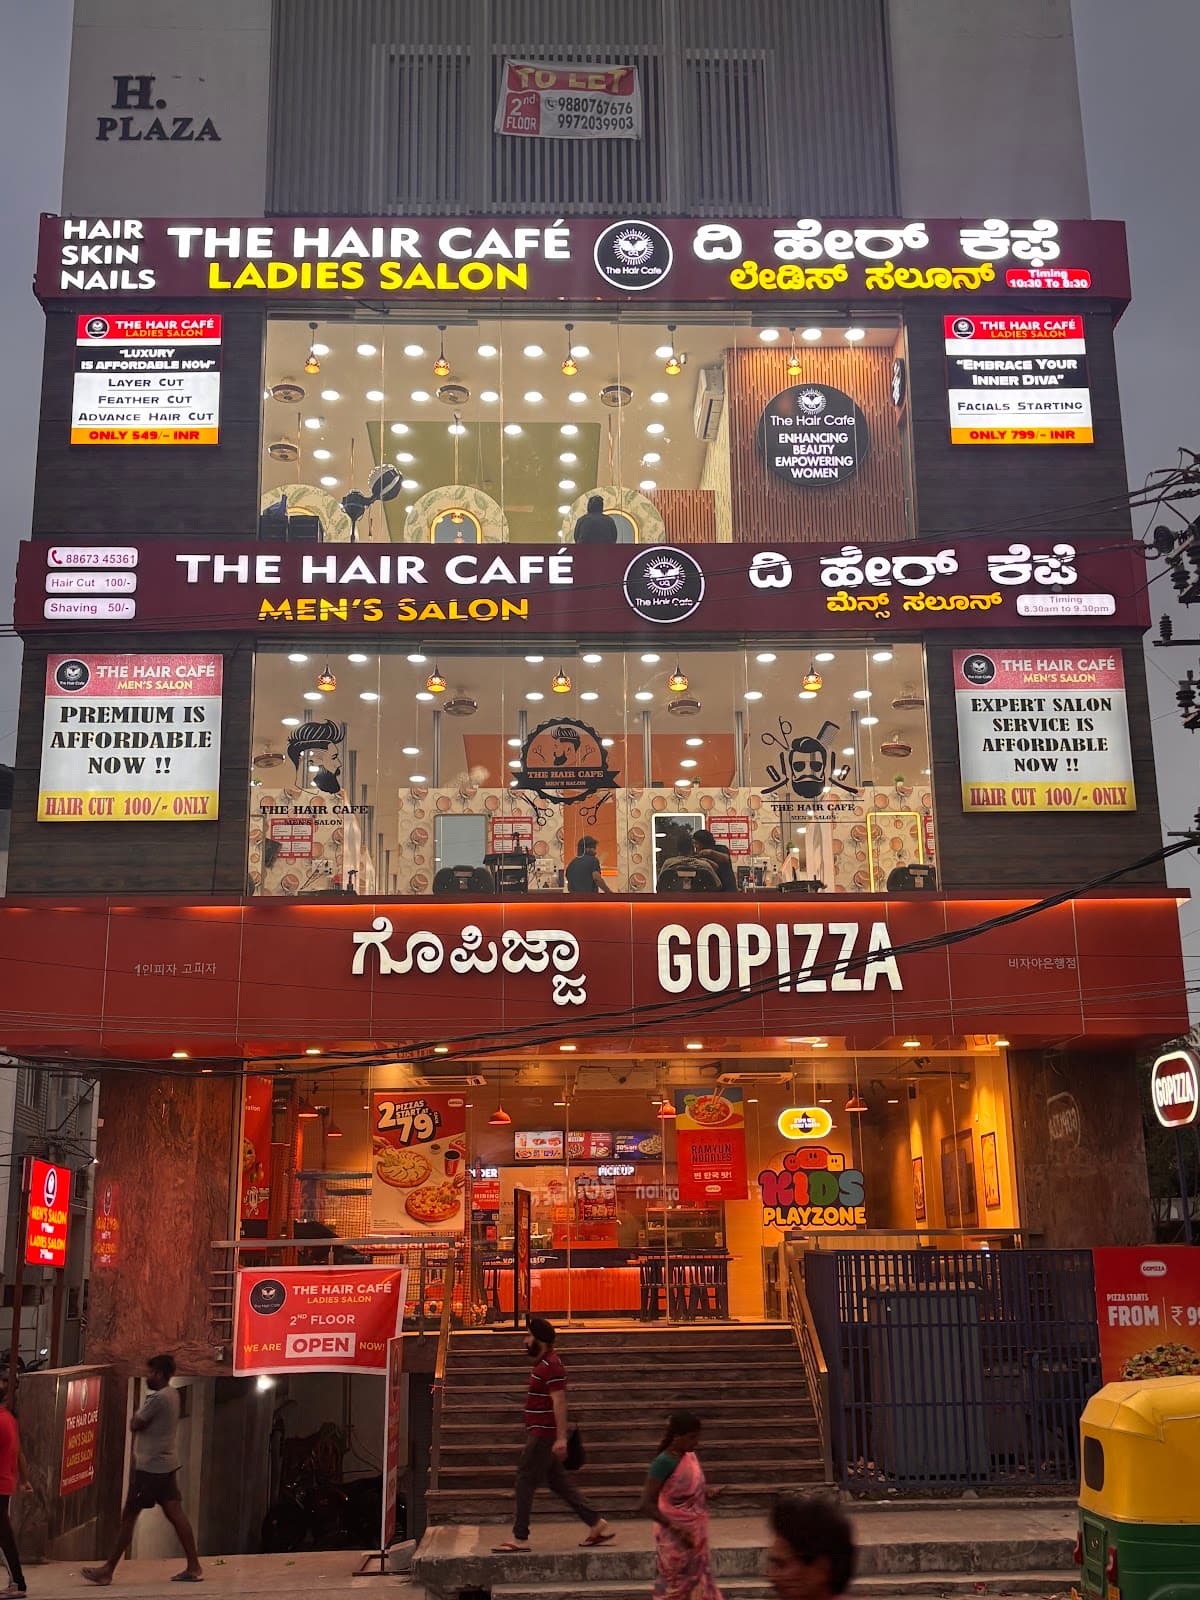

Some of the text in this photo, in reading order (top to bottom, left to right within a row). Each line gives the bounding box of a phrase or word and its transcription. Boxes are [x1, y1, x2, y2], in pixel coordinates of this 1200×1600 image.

[515, 67, 628, 93] TO LET
[112, 76, 167, 110] H.
[510, 93, 536, 116] 2nd
[558, 97, 633, 115] 9880767676
[96, 116, 221, 141] PLAZA
[506, 116, 537, 130] FLOOR
[558, 113, 633, 130] 9972039903
[62, 220, 144, 240] HAIR
[166, 219, 570, 259] THE HAIR CAFÉ
[693, 223, 742, 260] ದಿ
[773, 219, 929, 260] ಹೇರ್
[61, 244, 140, 265] SKIN
[208, 262, 528, 291] LADIES SALON
[606, 267, 621, 275] The
[621, 267, 639, 275] Hair
[1028, 270, 1068, 280] Timing
[60, 269, 157, 290] NAILS
[1010, 279, 1042, 288] 10:30
[1044, 279, 1060, 288] To
[115, 318, 214, 330] THE HAIR CAFÉ
[980, 319, 1076, 330] THE HAIR CAFÉ
[166, 329, 203, 337] SALON
[991, 330, 1066, 338] LADIES SALON
[95, 360, 180, 370] AFFORDABLE
[1035, 359, 1077, 369] YOUR
[159, 378, 184, 387] CUT
[972, 374, 1019, 386] INNER
[167, 395, 192, 404] CUT
[189, 413, 214, 421] CUT
[770, 415, 855, 426] The Hair Cafe
[89, 431, 199, 441] ONLY 549/- INR
[778, 433, 849, 444] ENHANCING
[970, 431, 1007, 440] ONLY
[1050, 430, 1075, 439] INR
[792, 444, 835, 455] BEAUTY
[775, 456, 854, 467] EMPOWERING
[791, 468, 839, 478] WOMEN
[66, 554, 135, 564] 88673 45361
[176, 547, 574, 584] THE HAIR CAFÉ
[749, 551, 792, 588] ದಿ
[51, 578, 130, 588] Hair Cut 100/-
[1050, 596, 1083, 604] Timing
[50, 603, 129, 614] Shaving 50/-
[257, 598, 529, 621] MEN'S SALON
[95, 662, 215, 678] THE HAIR CAFÉ
[1002, 655, 1116, 671] THE HAIR CAFÉ
[118, 680, 192, 690] MEN'S SALON
[1024, 673, 1096, 683] MEN'S SALON
[971, 697, 1112, 712] EXPERT SALON
[60, 706, 205, 723] PREMIUM IS
[992, 717, 1094, 732] SERVICE IS
[50, 731, 212, 749] AFFORDABLE
[982, 737, 1109, 752] AFFORDABLE
[88, 757, 146, 774] NOW
[1013, 758, 1058, 772] NOW
[970, 787, 1127, 806] HAIR CUT 100/- ONLY
[45, 796, 209, 816] HAIR CUT 100/- ONLY
[260, 805, 369, 815] THE HAIR CAFE
[771, 803, 855, 812] THE HAIR CAFE
[656, 922, 903, 993] GOPIZZA
[1156, 1072, 1194, 1107] GOPIZZA
[396, 1100, 424, 1111] PIZZAS
[378, 1101, 396, 1129] 2
[397, 1113, 434, 1142] 79
[758, 1170, 865, 1206] KIDS
[763, 1206, 867, 1226] PLAYZONE
[292, 1281, 392, 1296] THE HAIR CAFÉ
[341, 1296, 372, 1304] SALON
[1107, 1293, 1149, 1302] PIZZA STARTS
[290, 1313, 355, 1326] 2ND FLOOR
[1108, 1305, 1160, 1326] FROM
[244, 1344, 259, 1353] WE
[261, 1343, 282, 1352] ARE
[292, 1337, 349, 1353] OPEN
